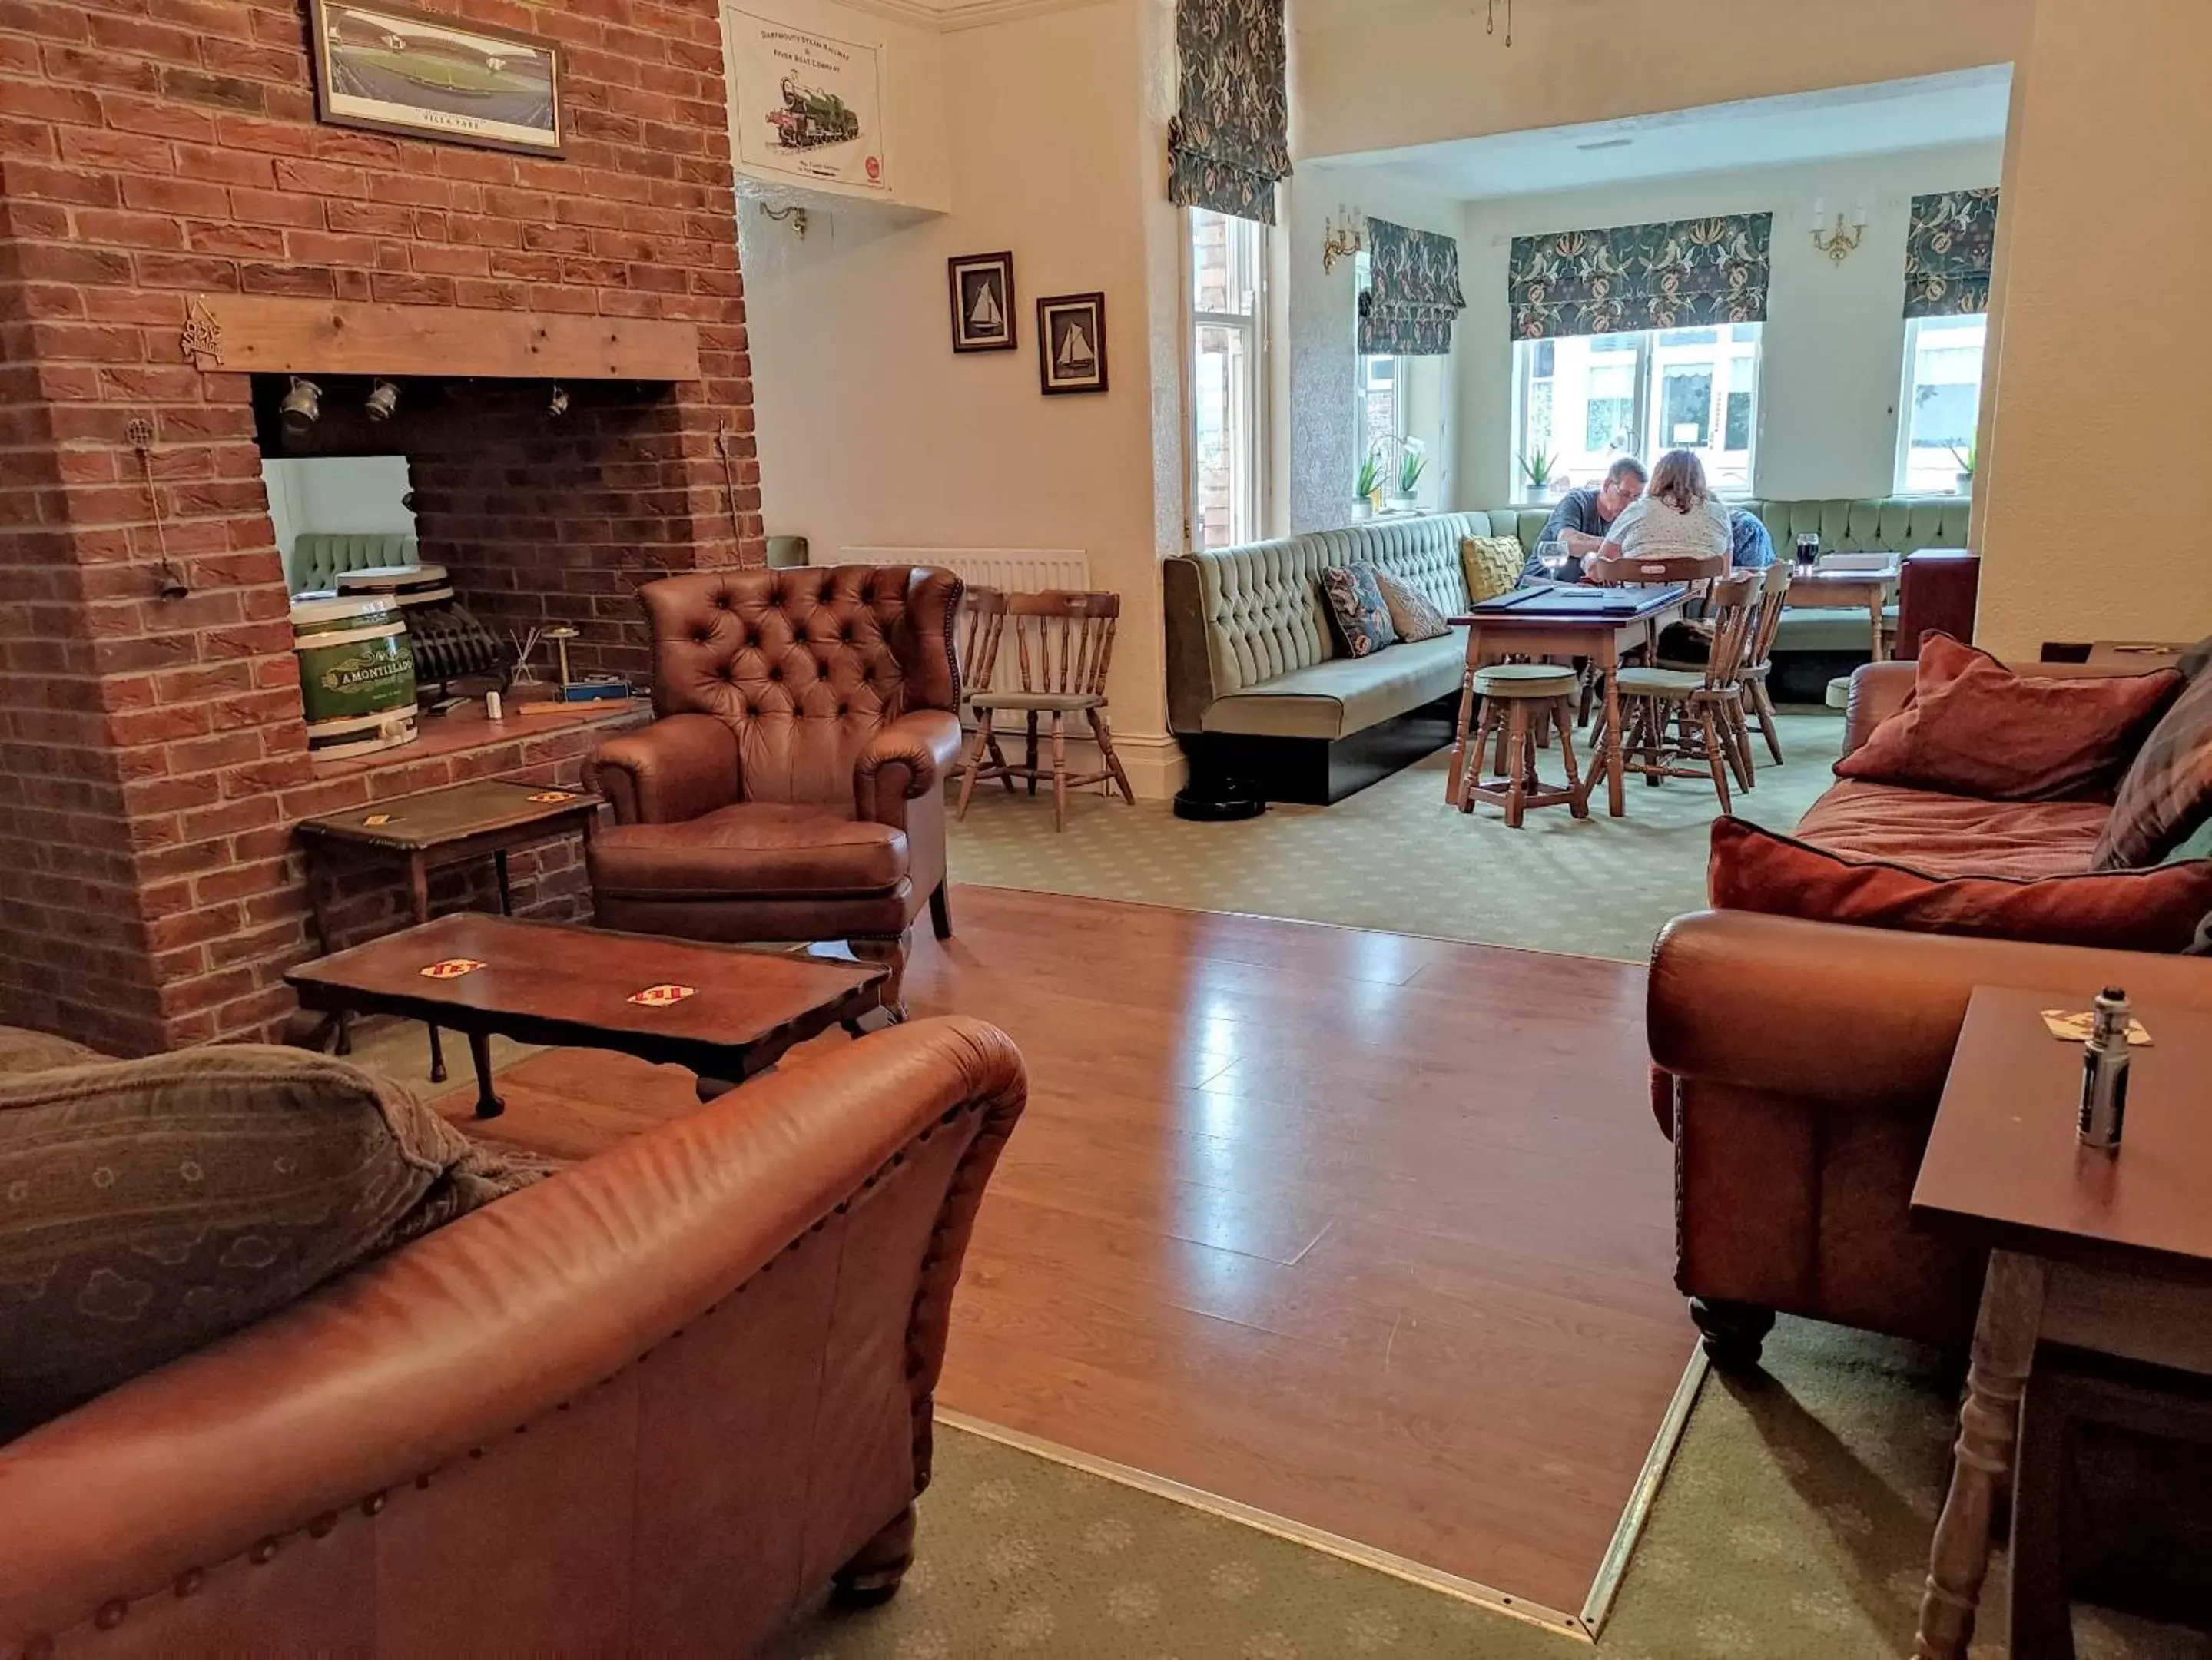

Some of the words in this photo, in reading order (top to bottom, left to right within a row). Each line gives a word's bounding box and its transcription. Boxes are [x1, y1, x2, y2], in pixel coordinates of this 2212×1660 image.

[801, 36, 822, 48] STEAM
[794, 55, 811, 65] BOAT
[812, 60, 841, 72] COMPANY
[343, 660, 413, 684] AMONTILLADO
